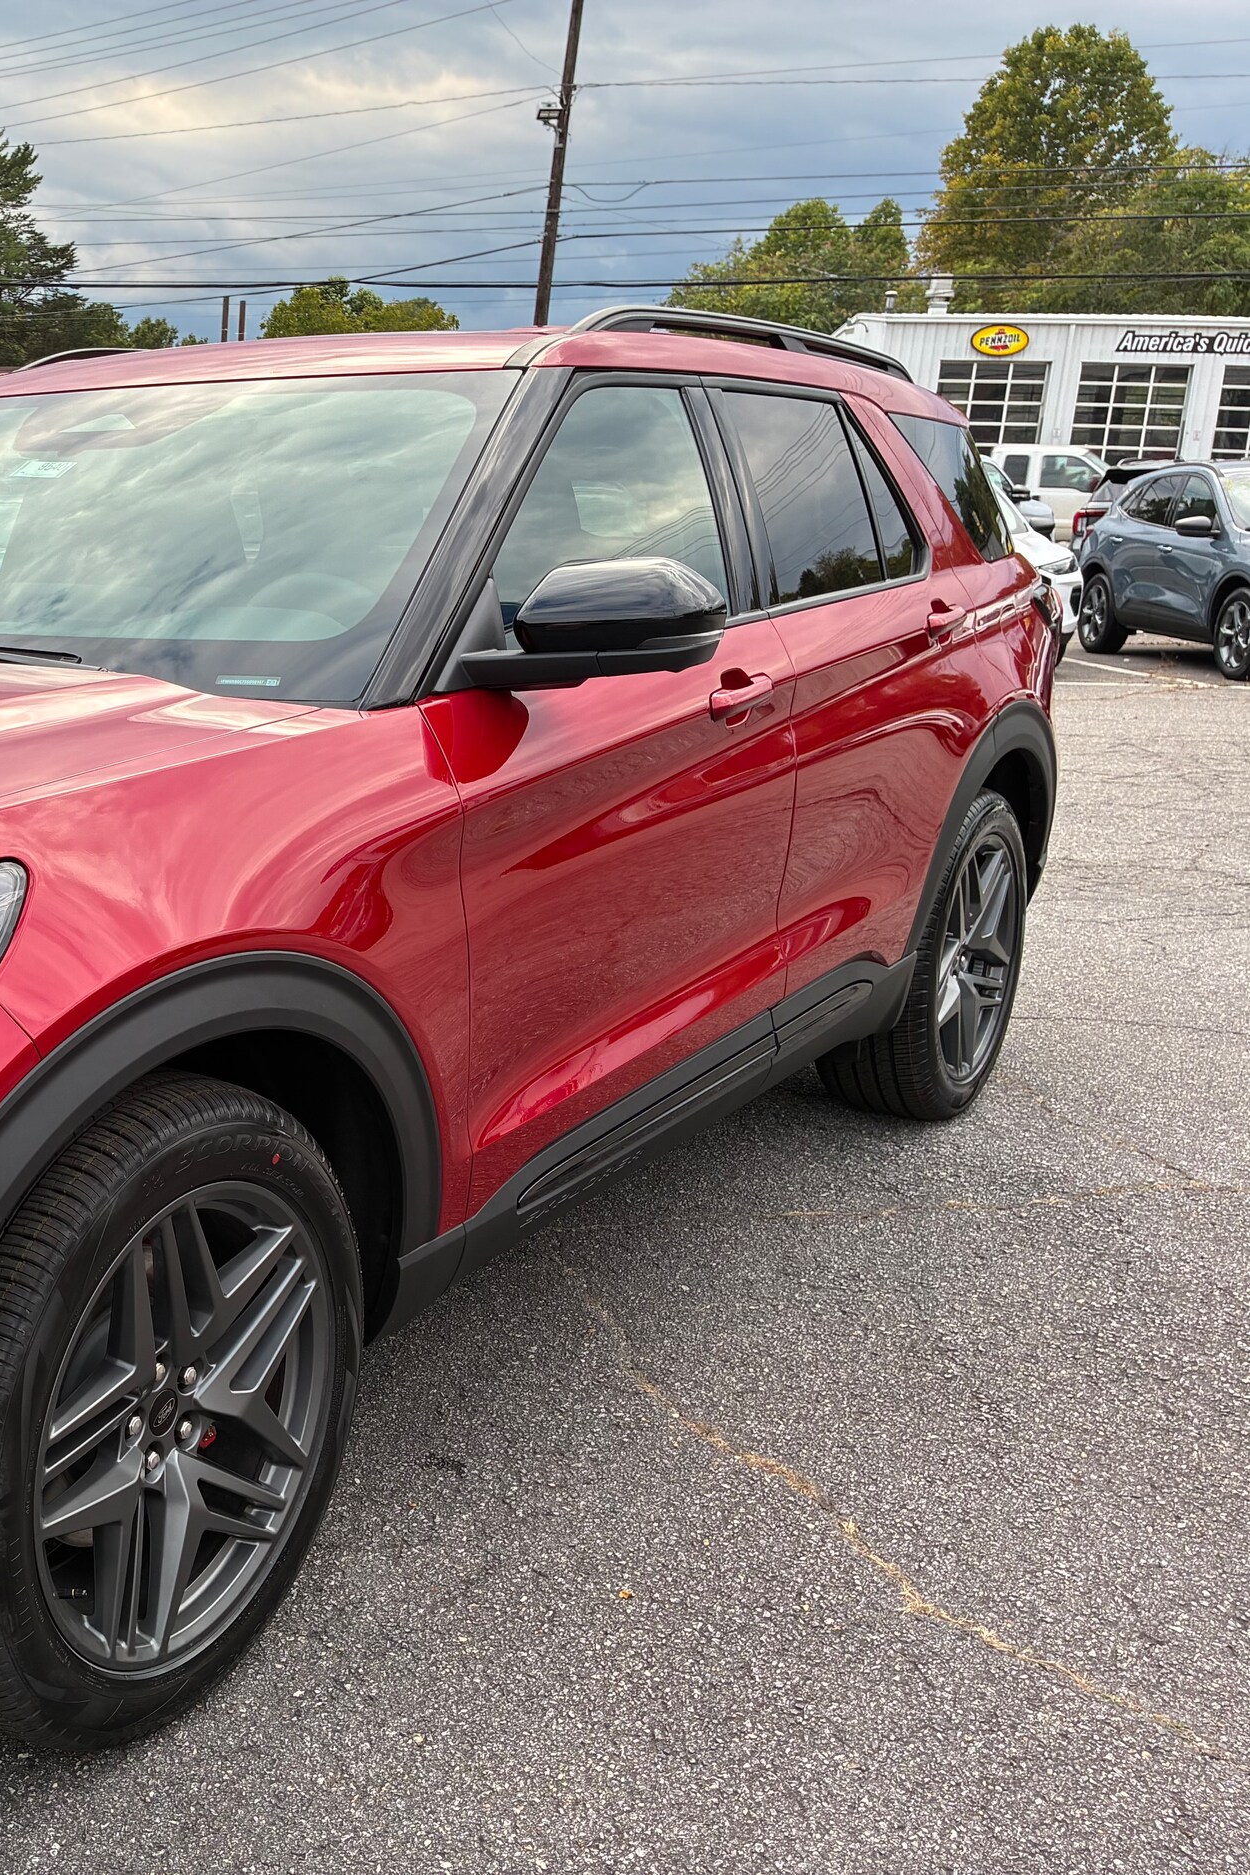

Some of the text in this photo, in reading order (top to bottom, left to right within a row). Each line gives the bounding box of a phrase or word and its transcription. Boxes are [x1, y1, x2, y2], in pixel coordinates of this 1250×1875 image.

[979, 333, 1021, 347] PENNZOIL
[1117, 331, 1210, 352] America's
[175, 1133, 310, 1174] SCORPION
